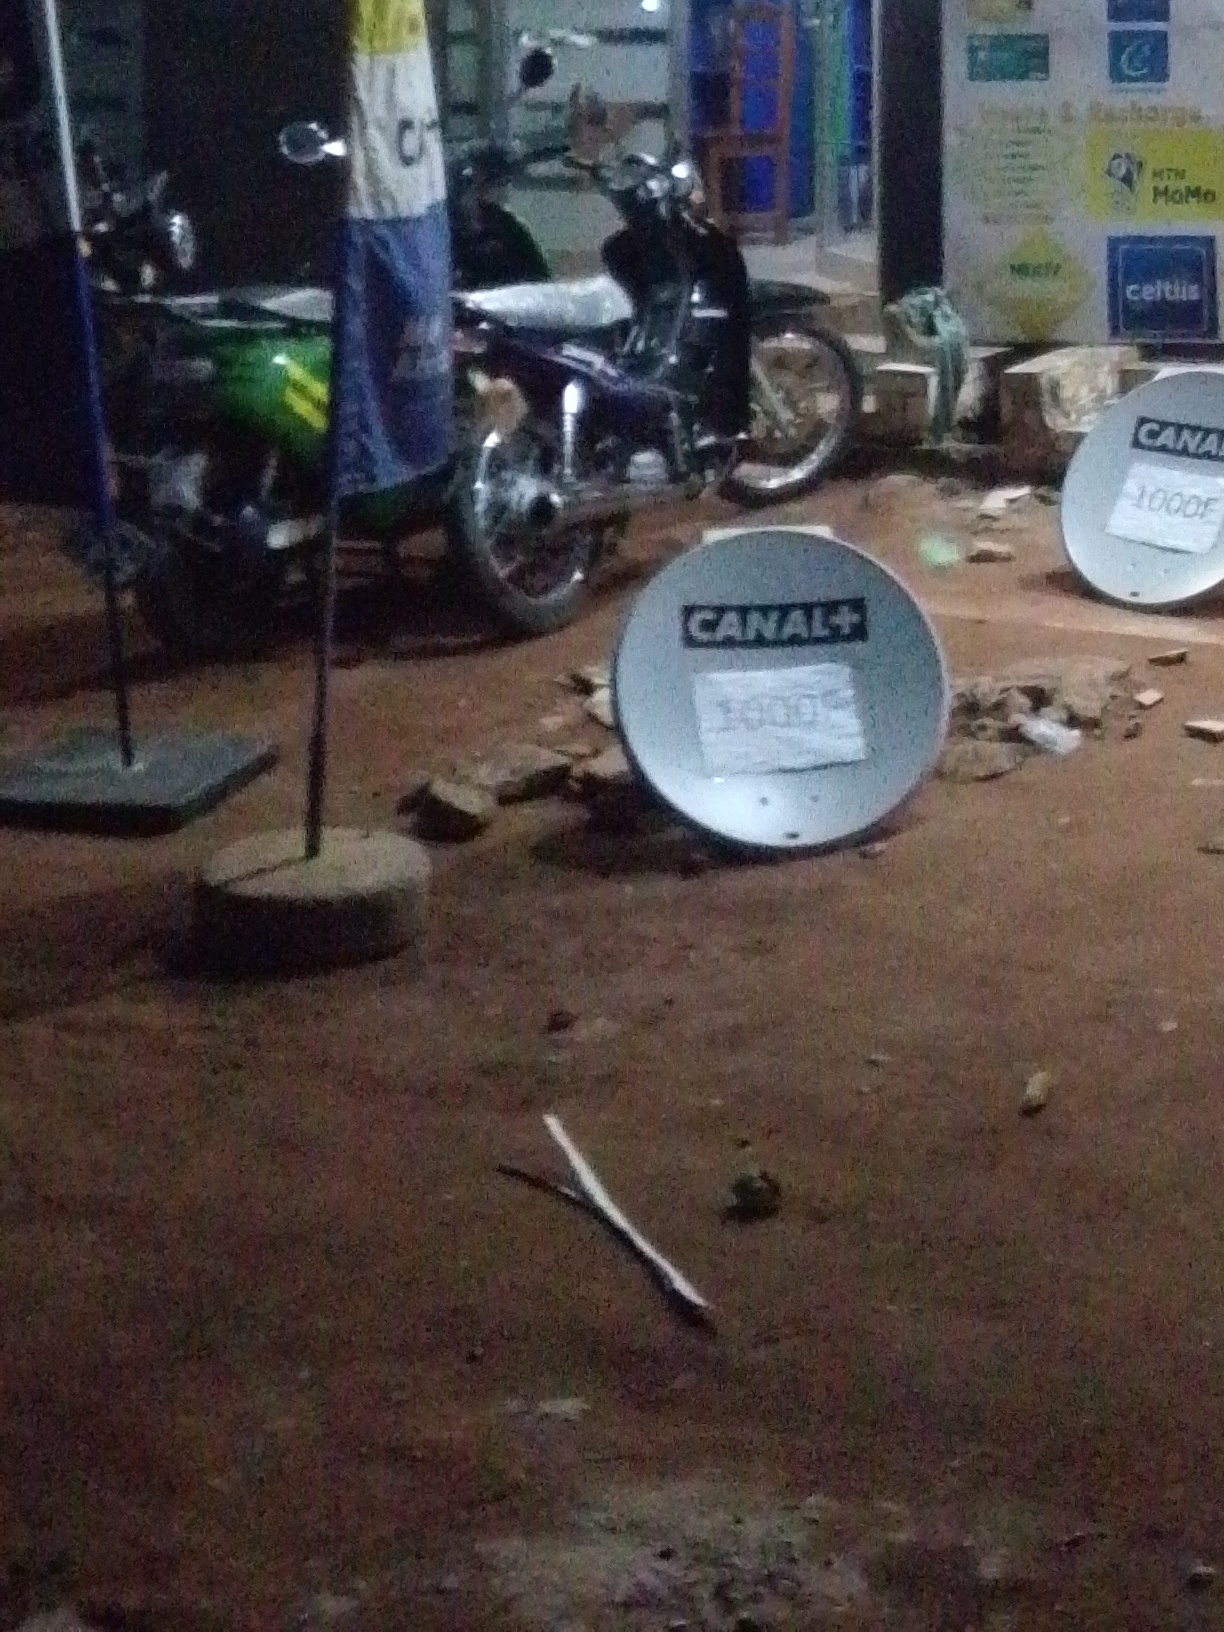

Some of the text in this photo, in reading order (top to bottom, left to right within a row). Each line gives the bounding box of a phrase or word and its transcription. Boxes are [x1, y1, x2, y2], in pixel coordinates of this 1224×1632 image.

[1152, 184, 1218, 206] MoMo
[1131, 485, 1221, 520] 1000F
[686, 603, 862, 643] CANAL+
